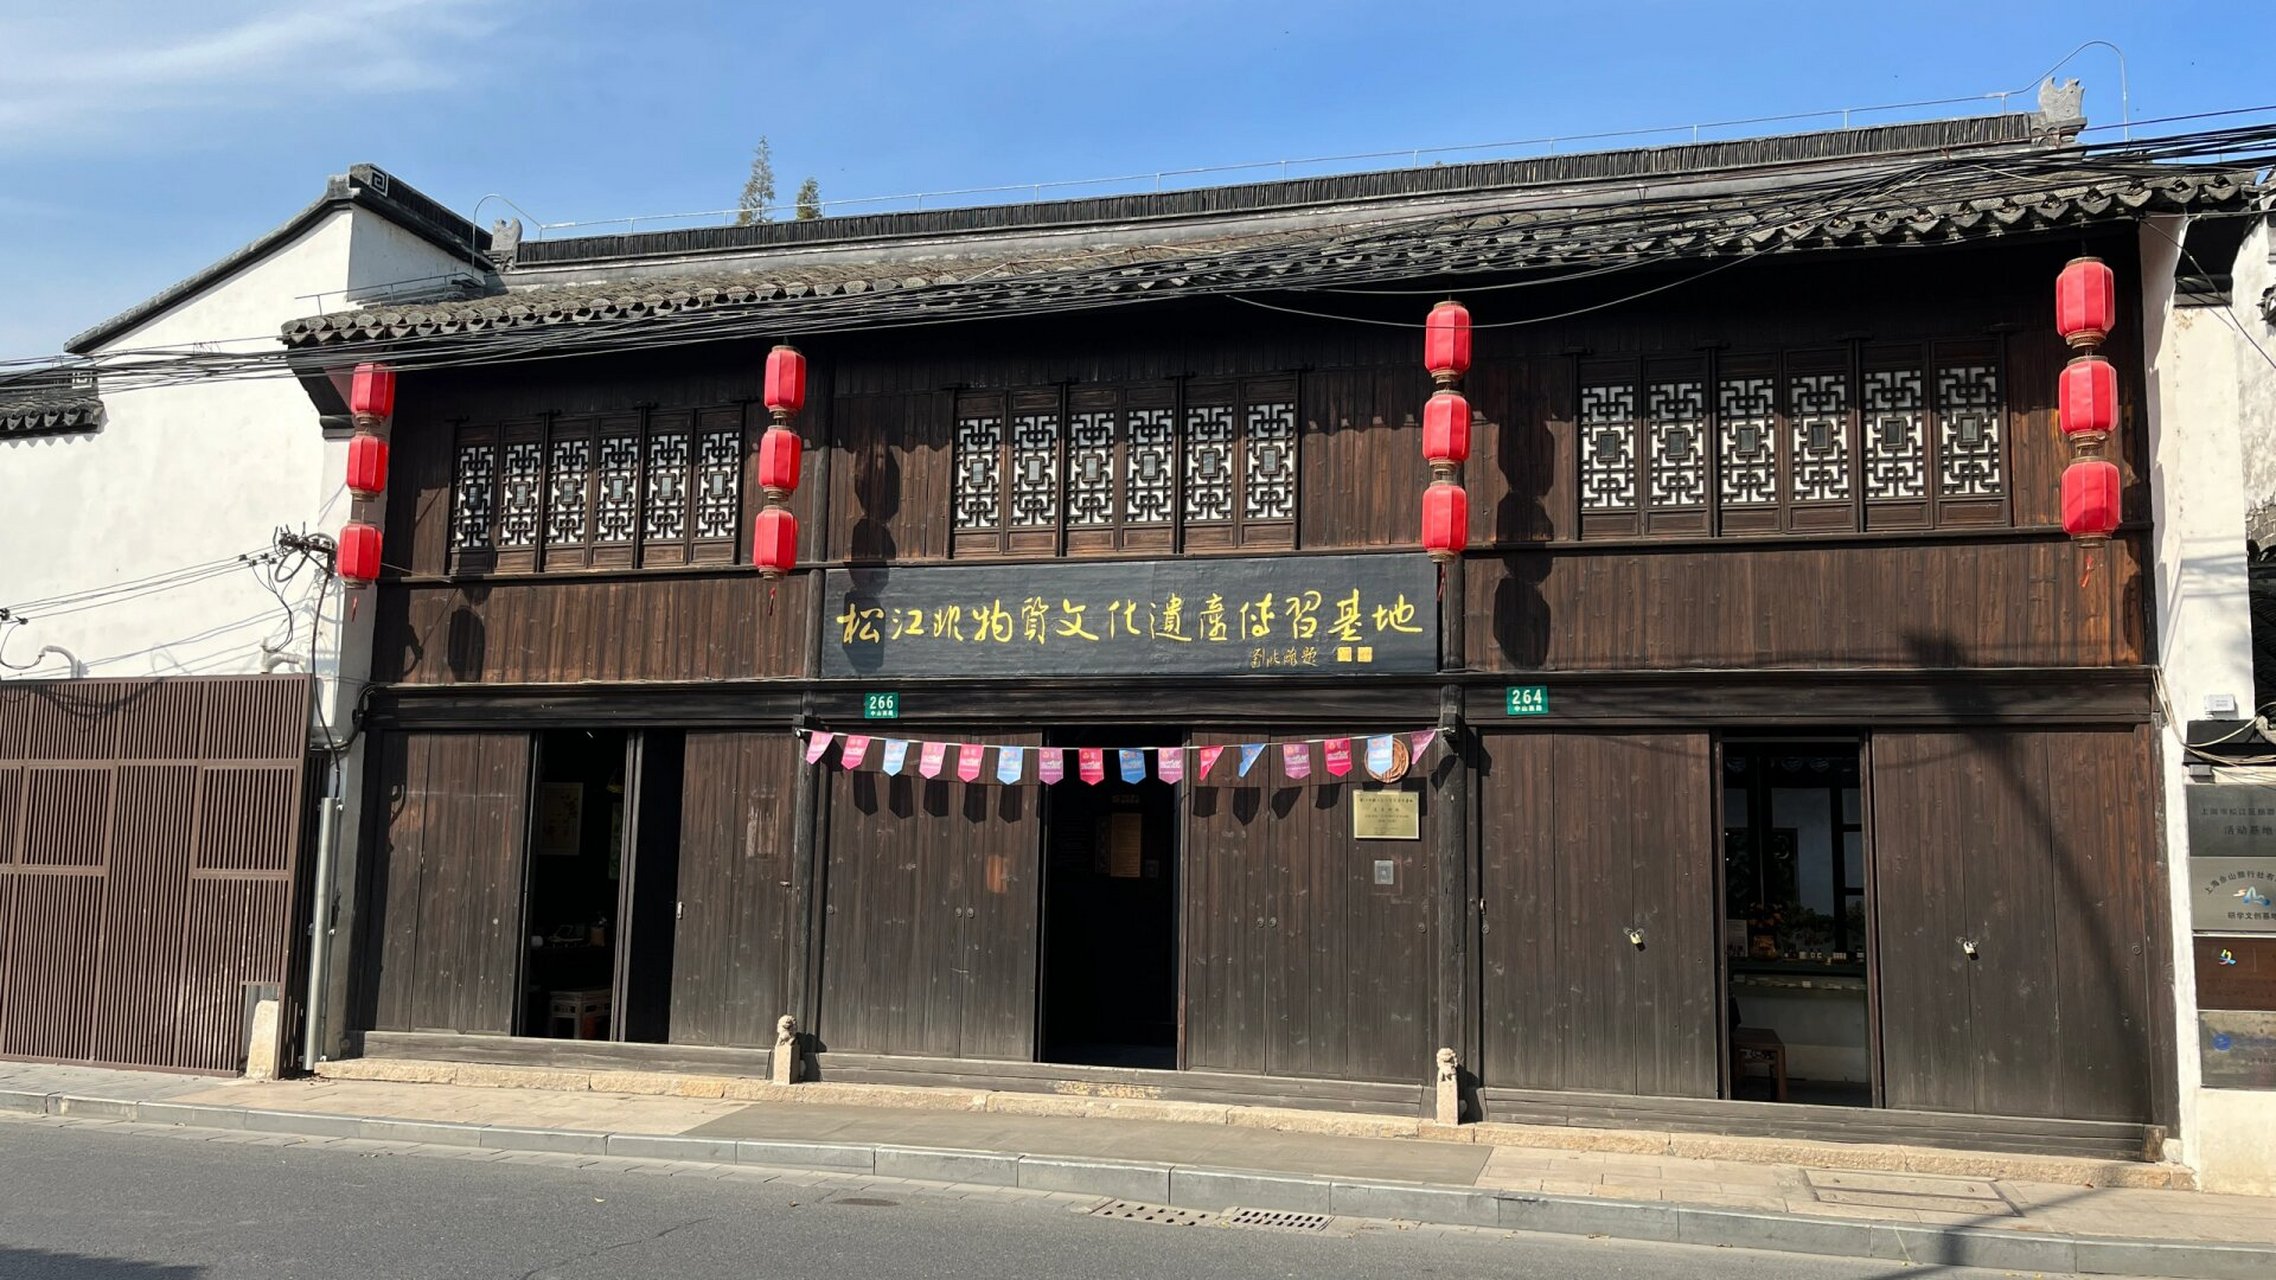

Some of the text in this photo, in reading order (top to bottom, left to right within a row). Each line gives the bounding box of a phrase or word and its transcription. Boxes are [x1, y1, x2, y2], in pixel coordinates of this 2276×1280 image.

[869, 695, 894, 710] 266
[1512, 688, 1542, 704] 264
[2204, 870, 2276, 895] 上海佘山旅行社有
